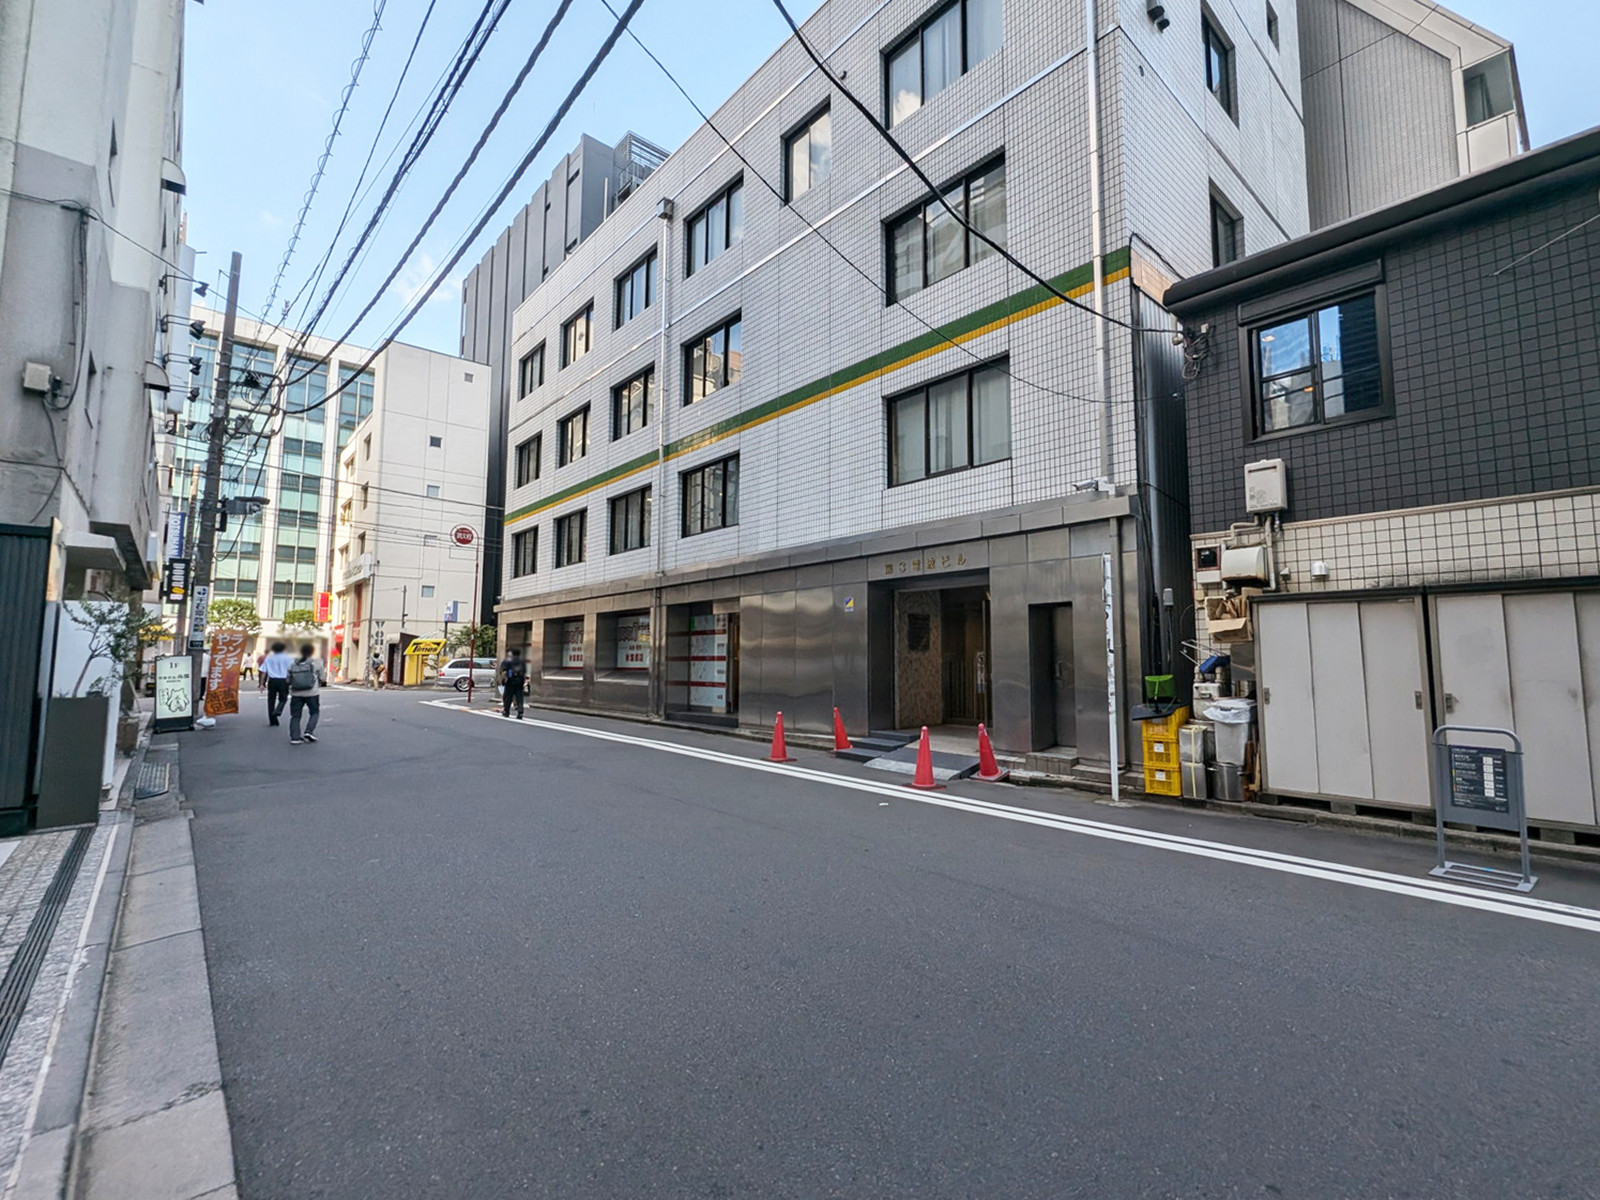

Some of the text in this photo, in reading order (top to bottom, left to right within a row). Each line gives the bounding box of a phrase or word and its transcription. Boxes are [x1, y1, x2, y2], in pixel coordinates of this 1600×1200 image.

[171, 563, 186, 600] DOUTOR
[209, 633, 231, 691] やってます
[225, 634, 244, 670] ランチ
[412, 642, 441, 653] Times
